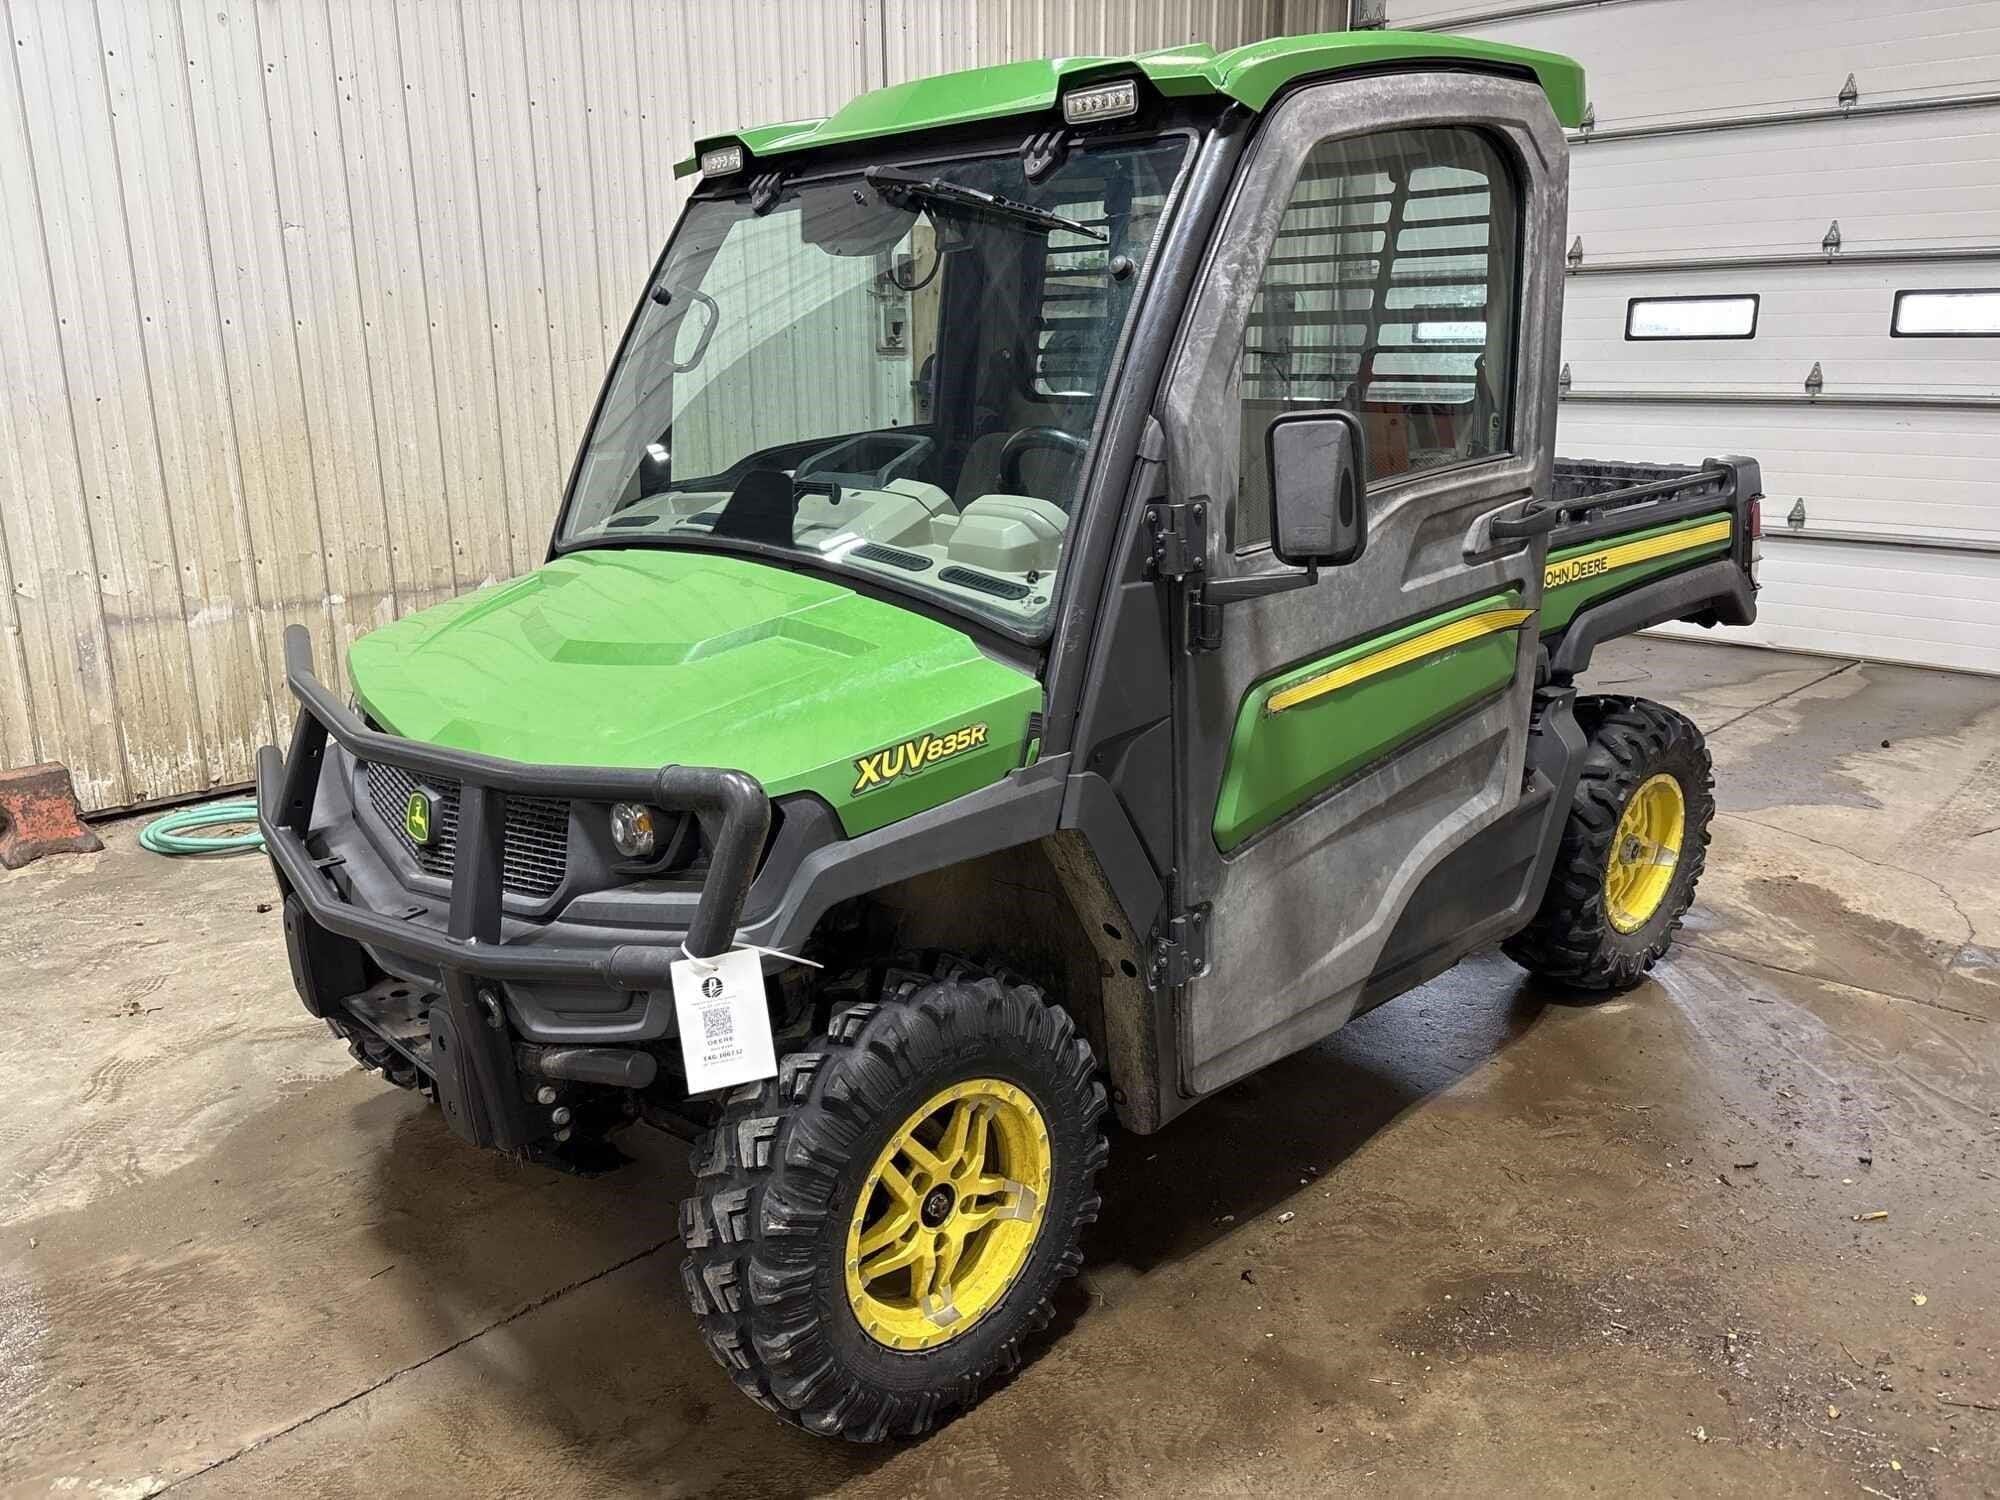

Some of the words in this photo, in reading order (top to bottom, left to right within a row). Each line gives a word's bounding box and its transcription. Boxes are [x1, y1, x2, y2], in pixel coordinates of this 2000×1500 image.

[1544, 567, 1570, 586] OHN
[1571, 556, 1608, 578] DEERE
[854, 724, 988, 791] XUV835R
